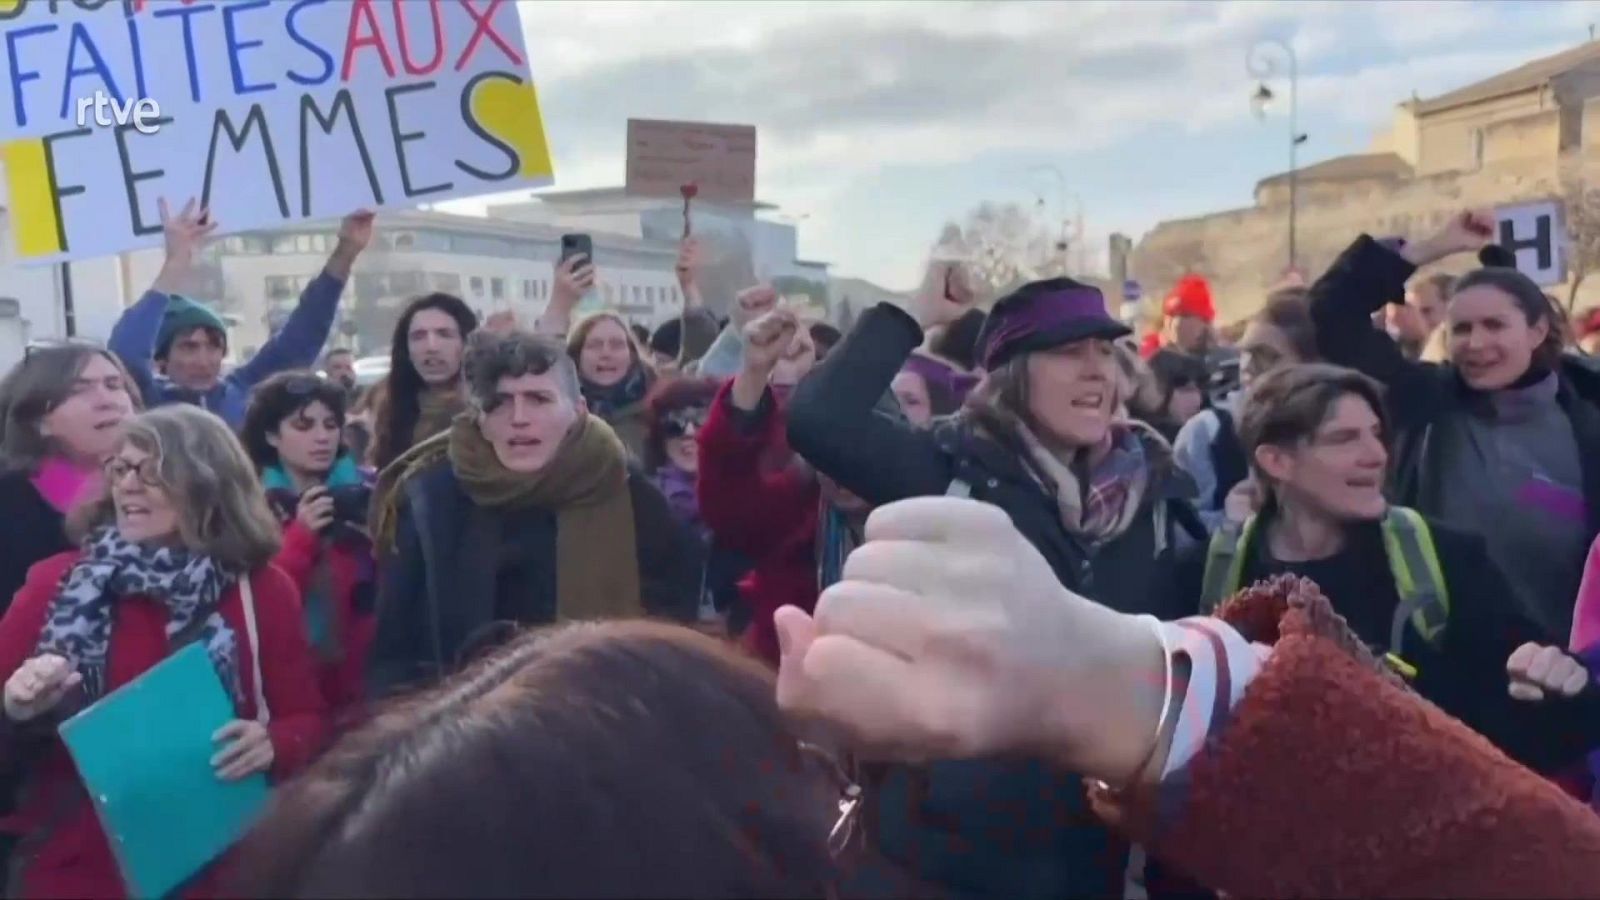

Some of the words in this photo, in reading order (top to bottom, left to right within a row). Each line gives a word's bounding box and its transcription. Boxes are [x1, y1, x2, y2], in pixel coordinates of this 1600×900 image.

[5, 0, 335, 126] FAITES
[340, 0, 523, 82] AUX
[42, 70, 524, 253] FEMMES
[1499, 214, 1551, 270] H
